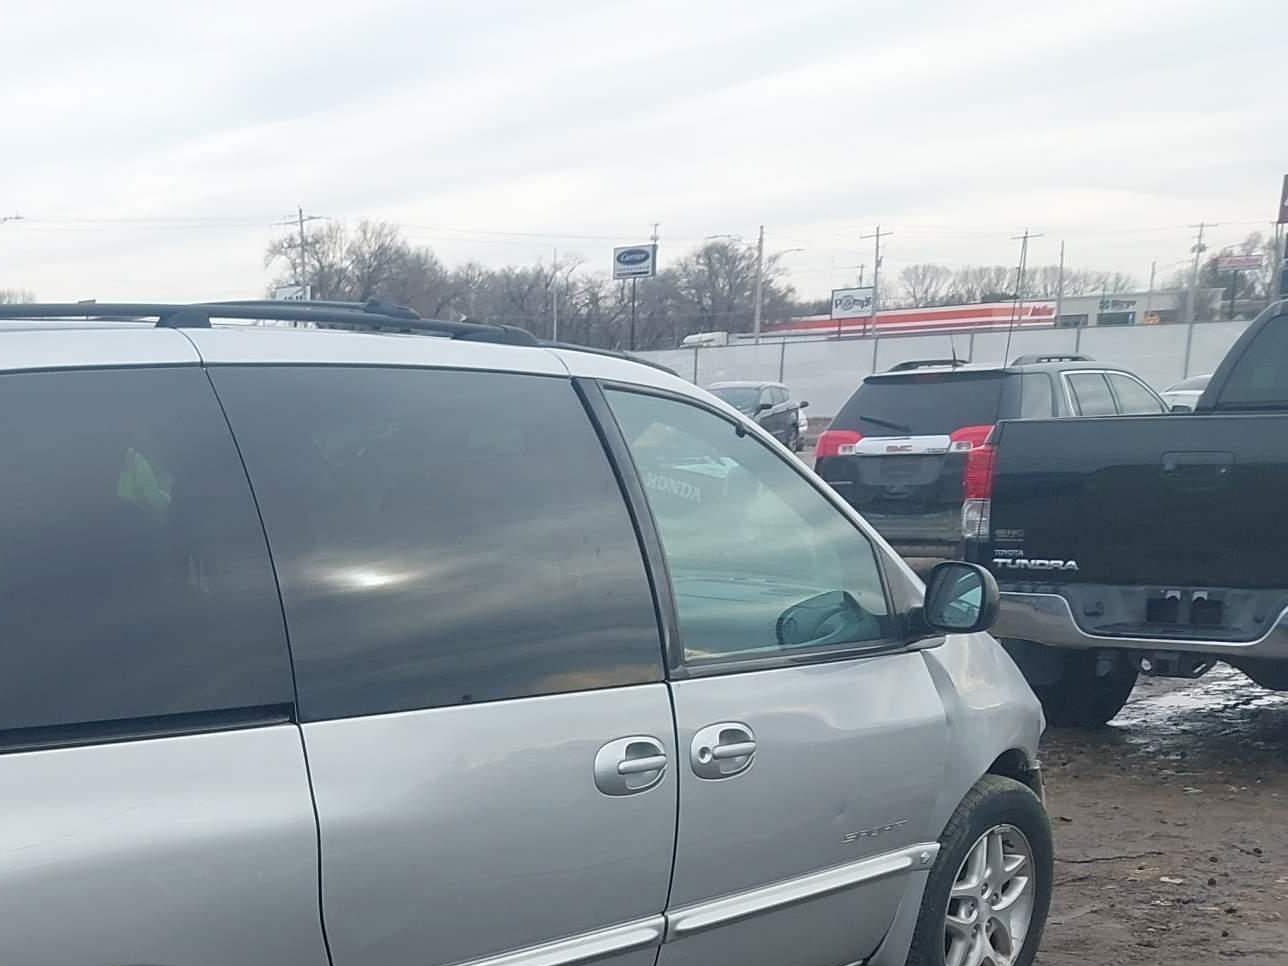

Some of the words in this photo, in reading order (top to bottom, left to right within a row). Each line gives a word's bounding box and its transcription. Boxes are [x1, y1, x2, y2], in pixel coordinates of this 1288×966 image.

[645, 472, 702, 502] HONDA
[993, 549, 1025, 557] TOYOTA
[992, 558, 1080, 571] TUNDRA
